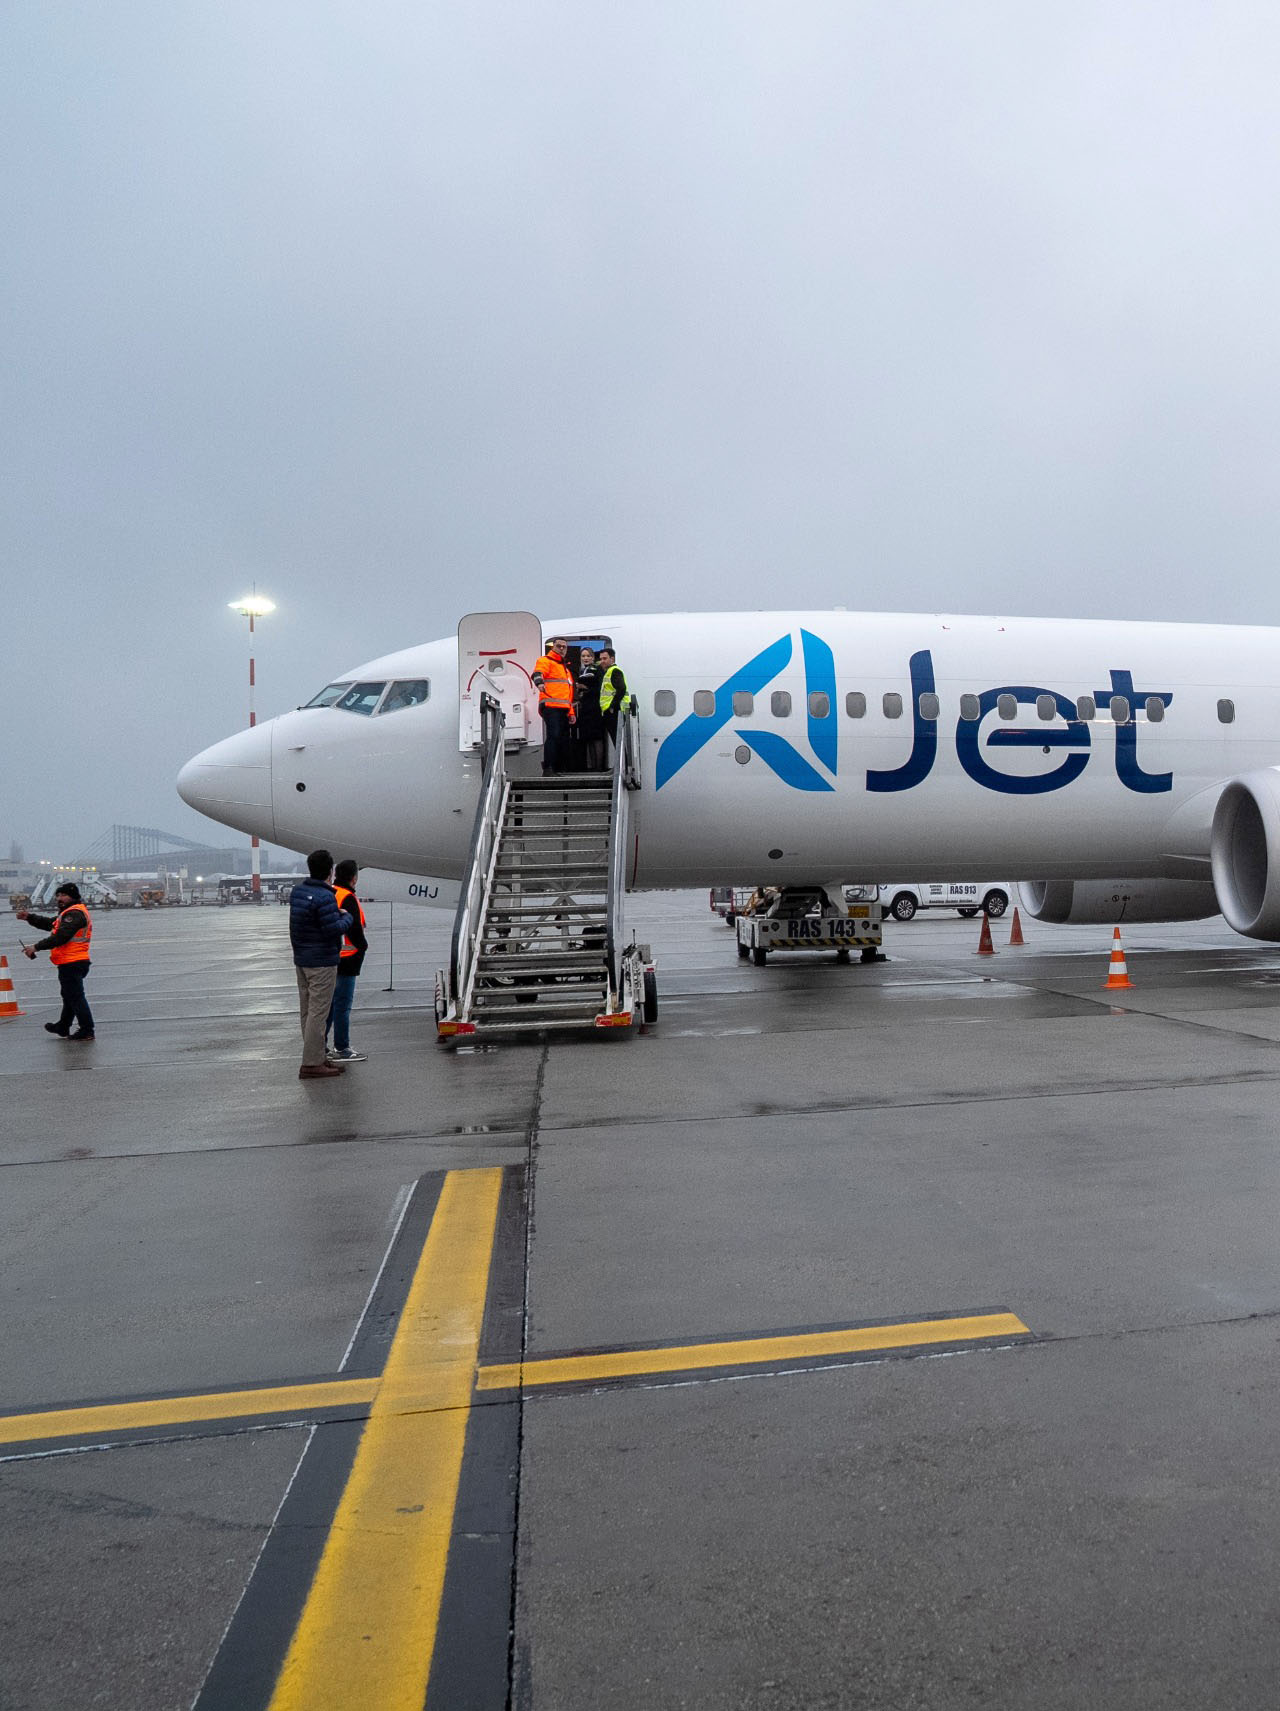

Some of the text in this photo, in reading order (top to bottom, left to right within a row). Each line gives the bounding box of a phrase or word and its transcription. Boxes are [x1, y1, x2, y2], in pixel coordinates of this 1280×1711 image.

[408, 884, 439, 899] OHJ
[949, 885, 963, 895] RAS
[964, 885, 977, 895] 913
[787, 919, 856, 938] RAS 143
